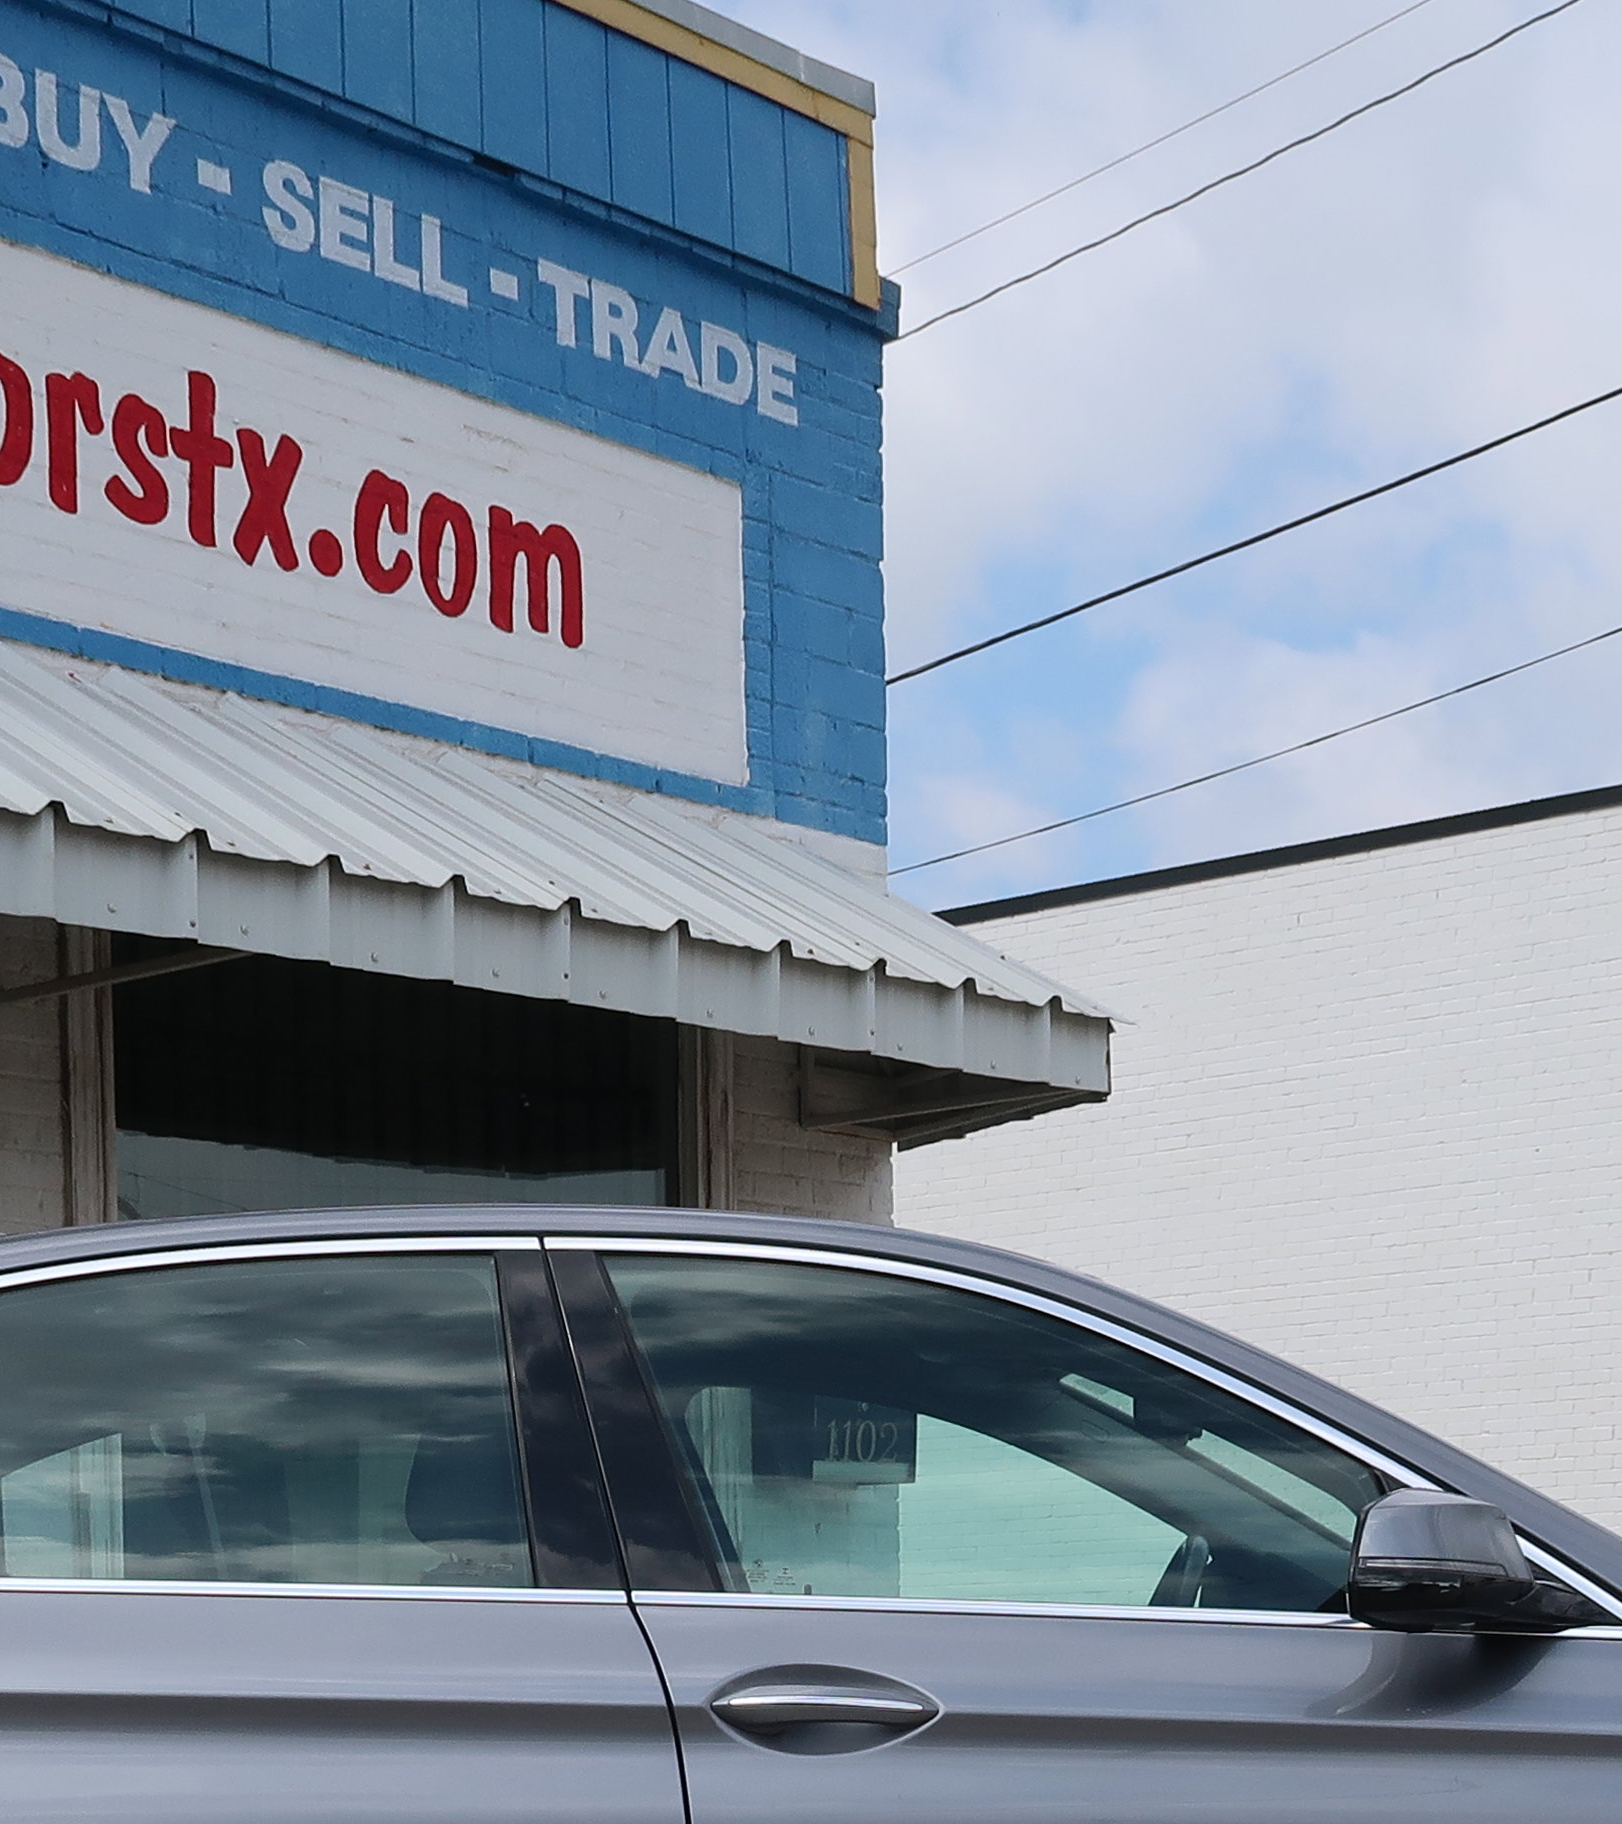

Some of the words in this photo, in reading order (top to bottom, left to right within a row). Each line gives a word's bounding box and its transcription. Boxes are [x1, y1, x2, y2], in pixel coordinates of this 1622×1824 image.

[262, 160, 469, 308] SELL
[537, 260, 799, 427] TRADE
[827, 1419, 898, 1463] 1102
